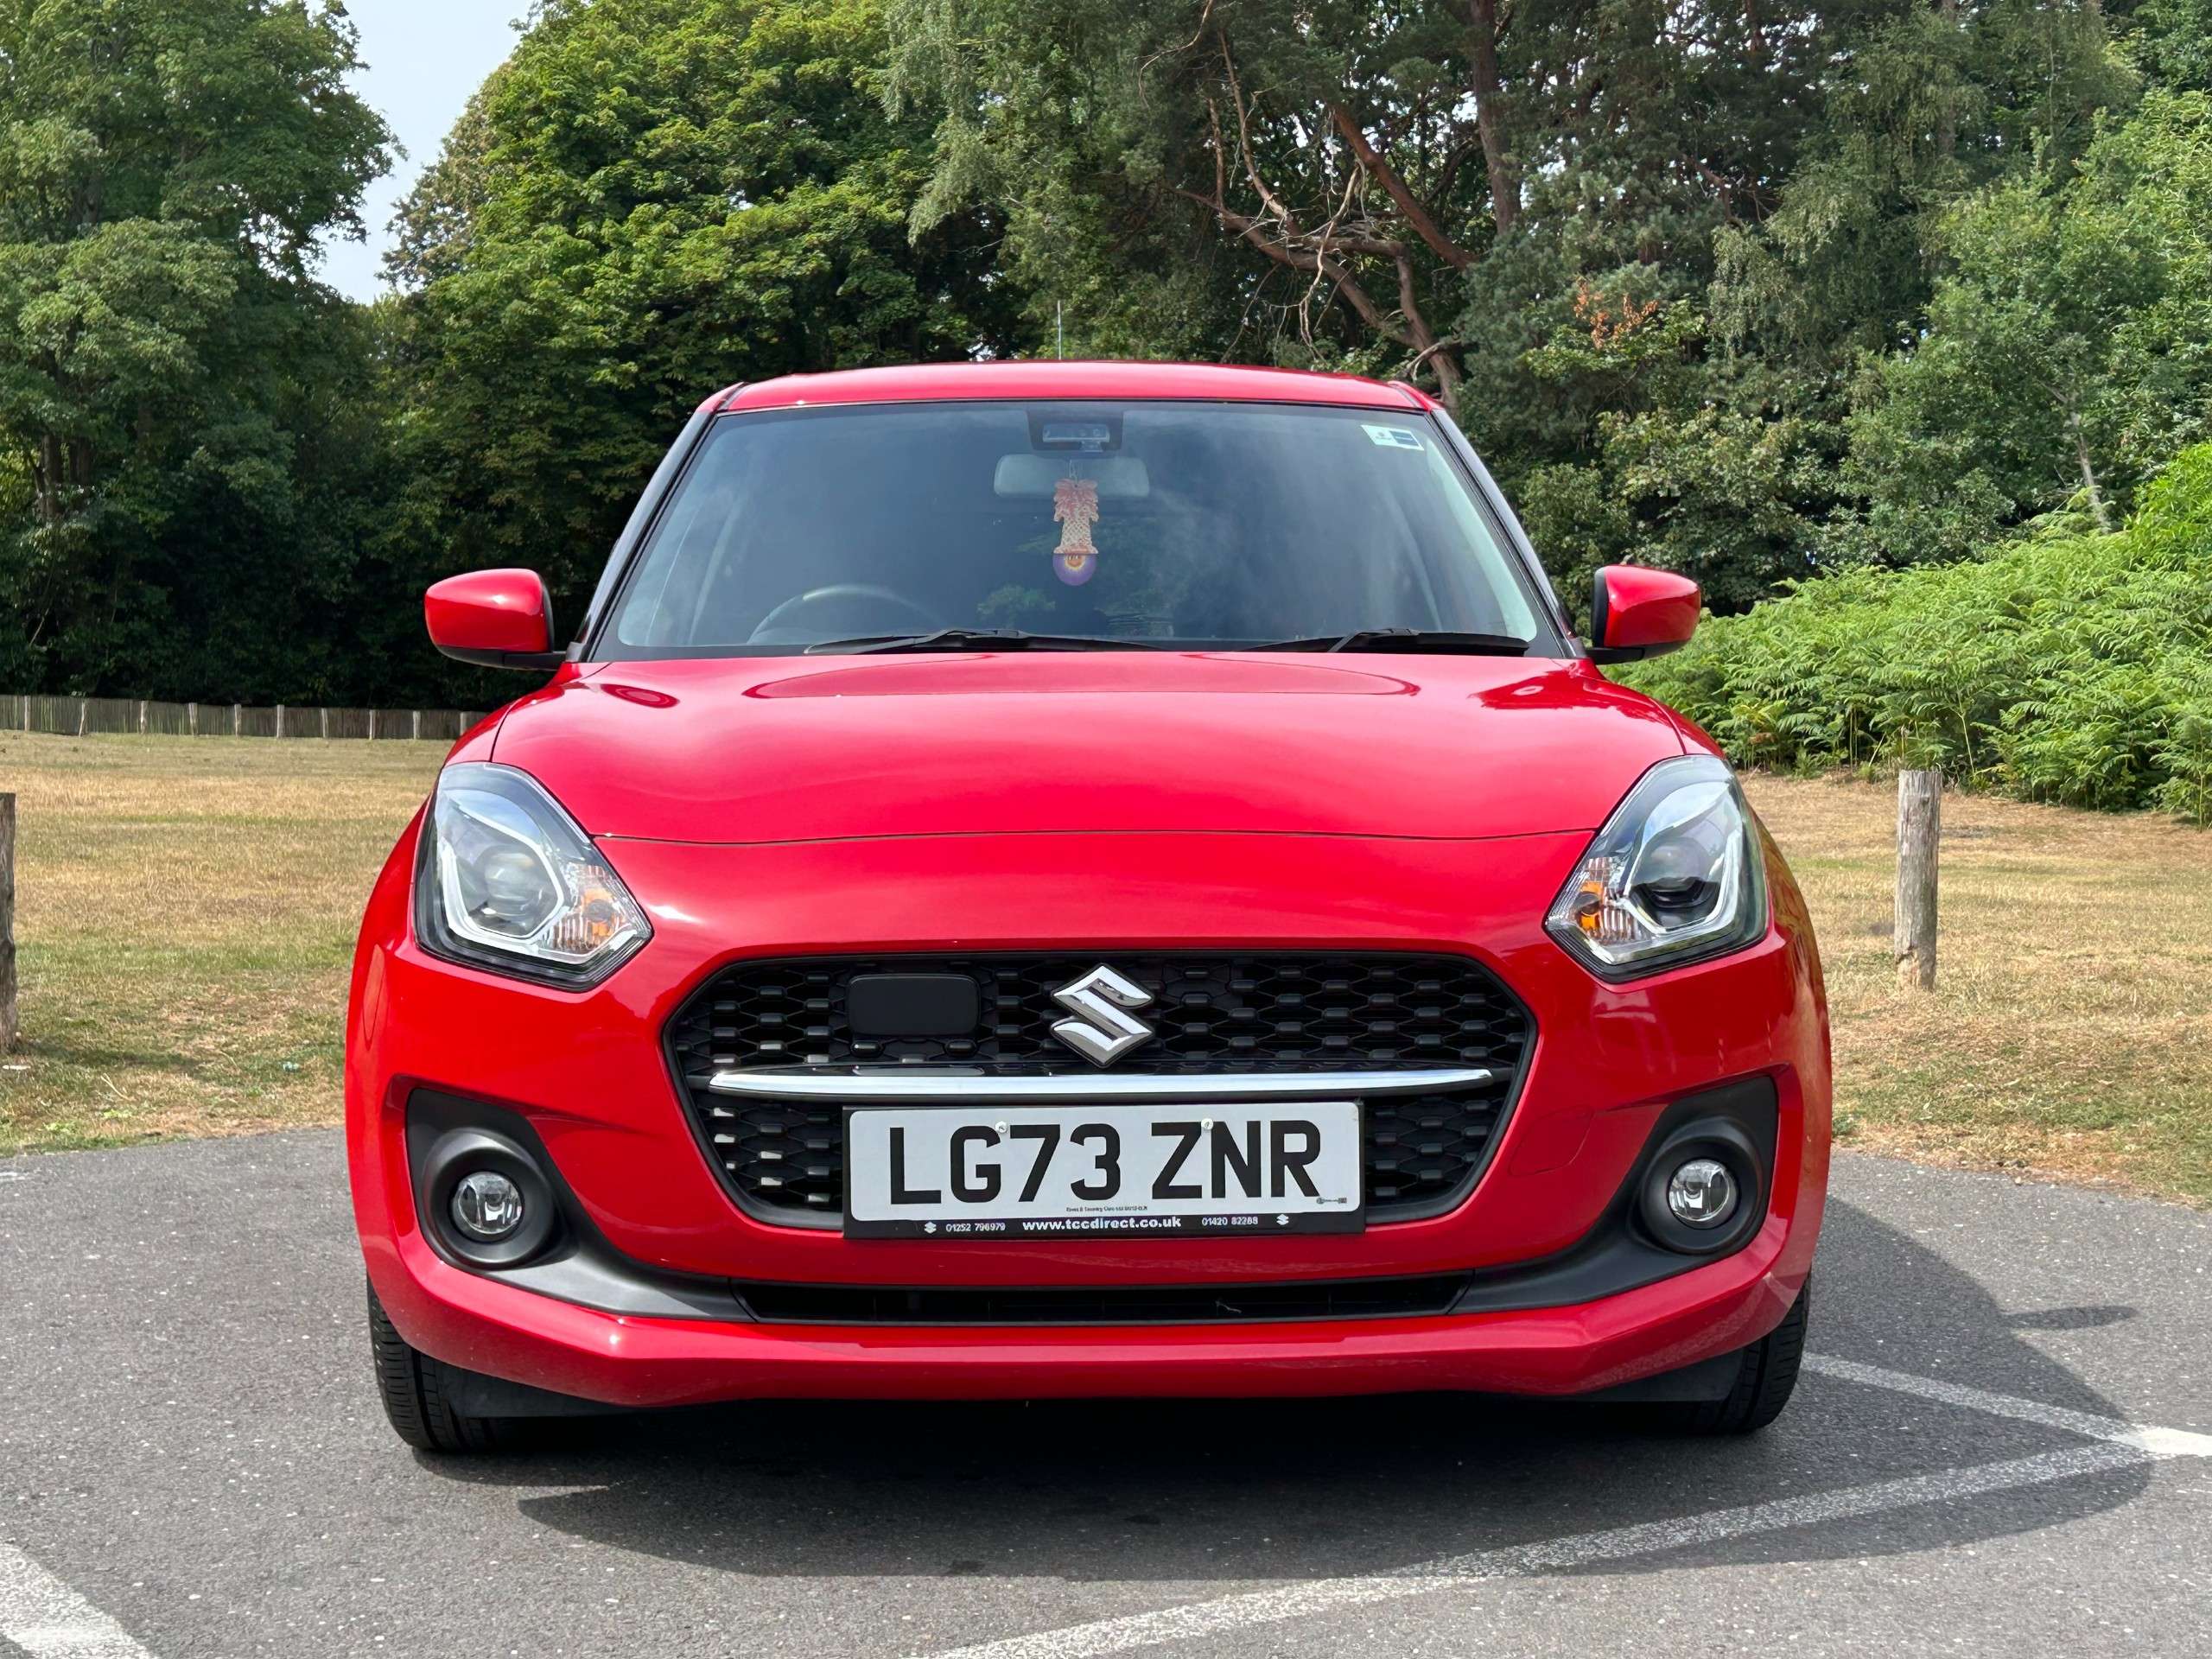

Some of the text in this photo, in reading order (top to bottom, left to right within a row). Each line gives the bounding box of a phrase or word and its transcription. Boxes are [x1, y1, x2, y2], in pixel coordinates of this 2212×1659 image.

[890, 1120, 1321, 1205] LG73 ZNR
[1022, 1217, 1182, 1230] www.tccdirect.co.uk
